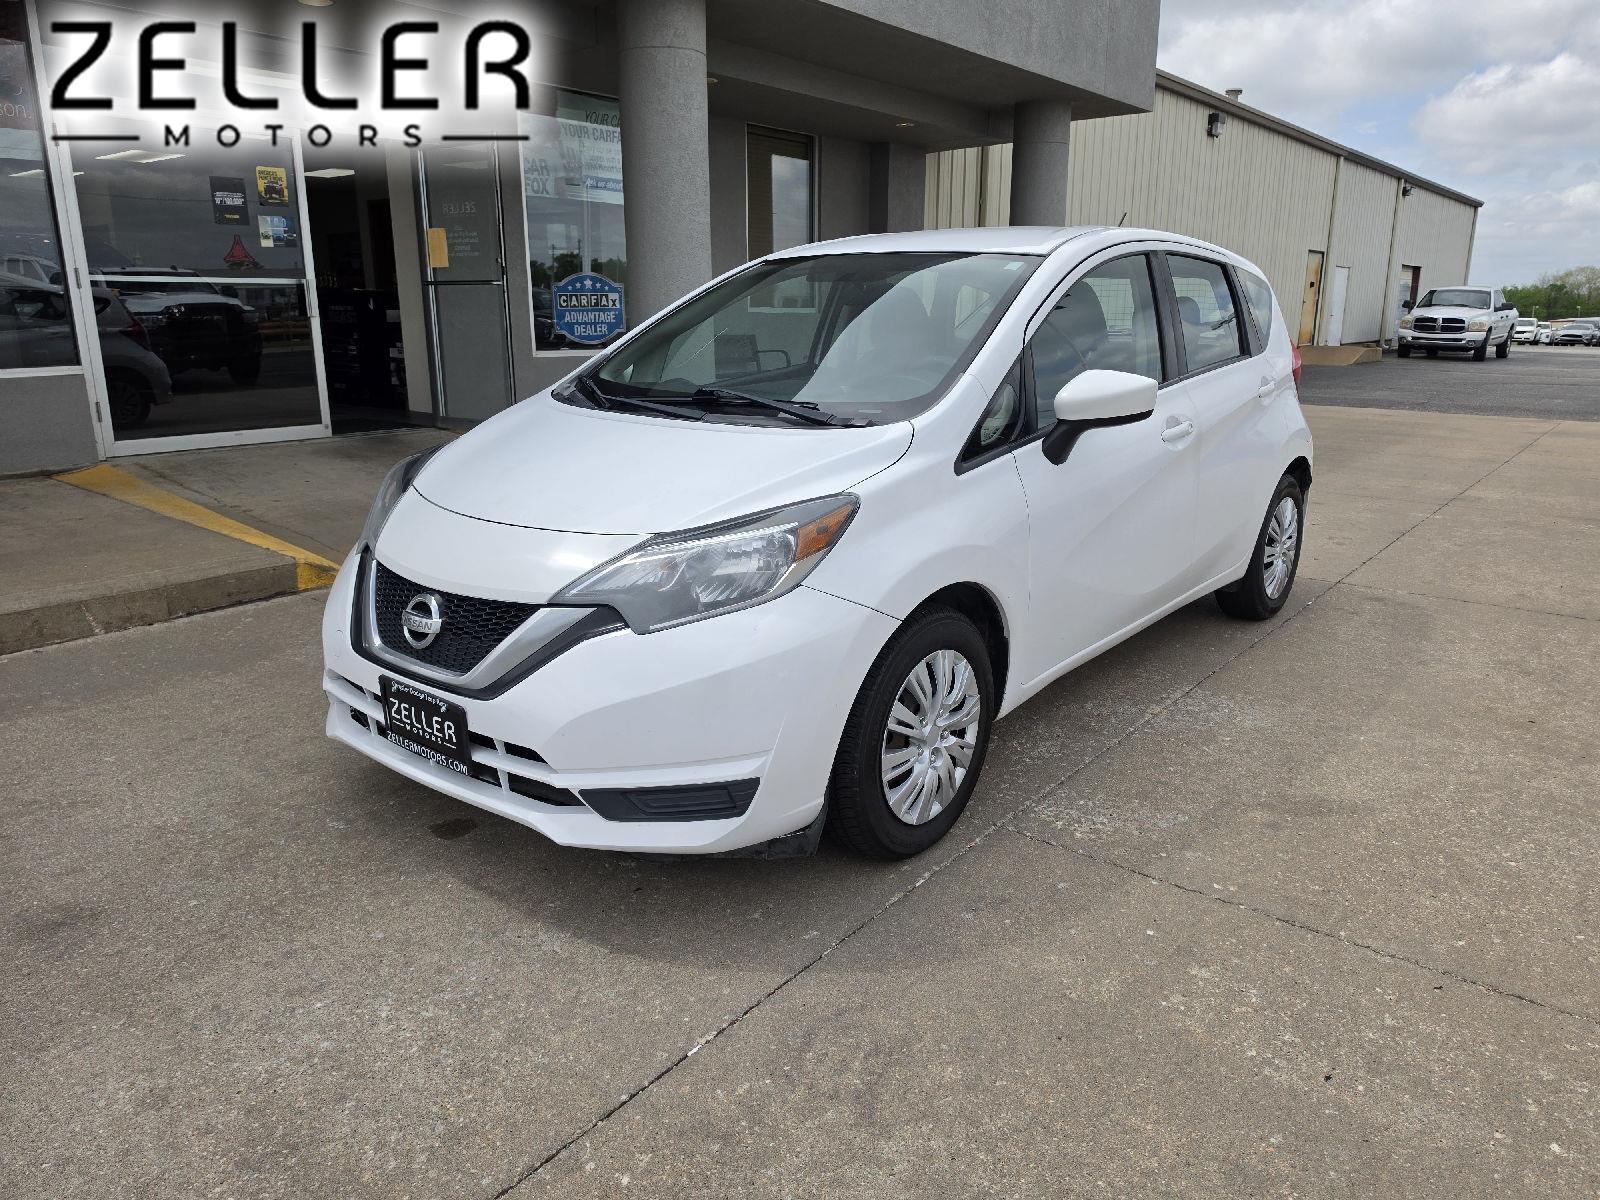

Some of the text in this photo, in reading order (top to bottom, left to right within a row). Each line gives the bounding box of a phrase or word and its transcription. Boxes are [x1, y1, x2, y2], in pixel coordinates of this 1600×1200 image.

[585, 110, 609, 125] YOUR
[561, 122, 590, 139] YOUR
[560, 295, 618, 307] CARFAX
[565, 311, 616, 322] ADVANTAGE
[574, 324, 608, 335] DEALER
[402, 614, 433, 631] NISSAN
[390, 697, 456, 742] ZELLER
[406, 723, 441, 744] MOTORS
[387, 730, 468, 775] ZELLERMOTORS.COM
